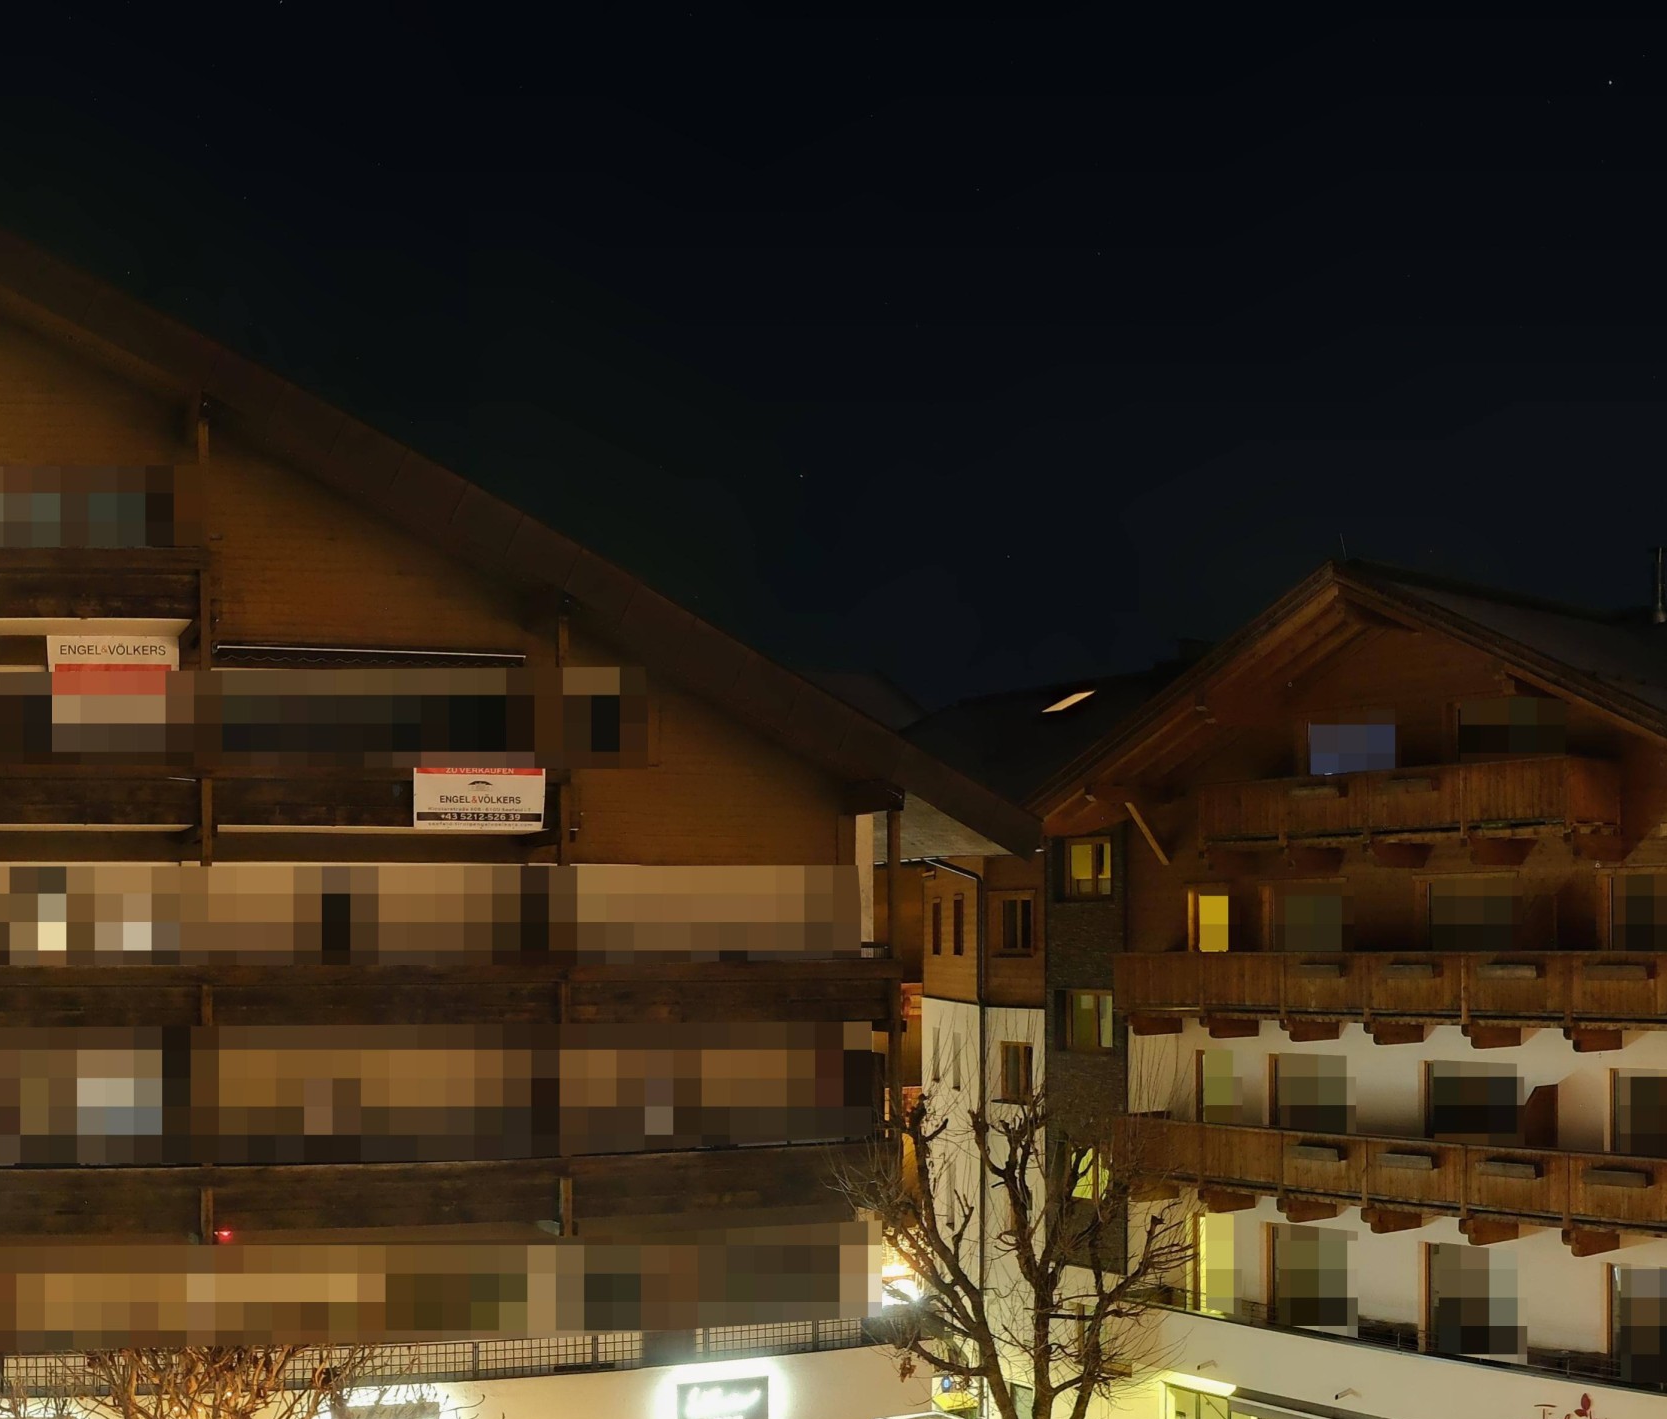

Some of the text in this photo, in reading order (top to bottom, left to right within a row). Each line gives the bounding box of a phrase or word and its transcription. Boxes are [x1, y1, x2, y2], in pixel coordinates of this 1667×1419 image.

[59, 643, 167, 656] ENGEL&VÖLKERS
[461, 767, 515, 775] VERKAUFEN
[439, 794, 522, 805] ENGEL&VÖLKERS
[460, 813, 506, 821] 5212-526
